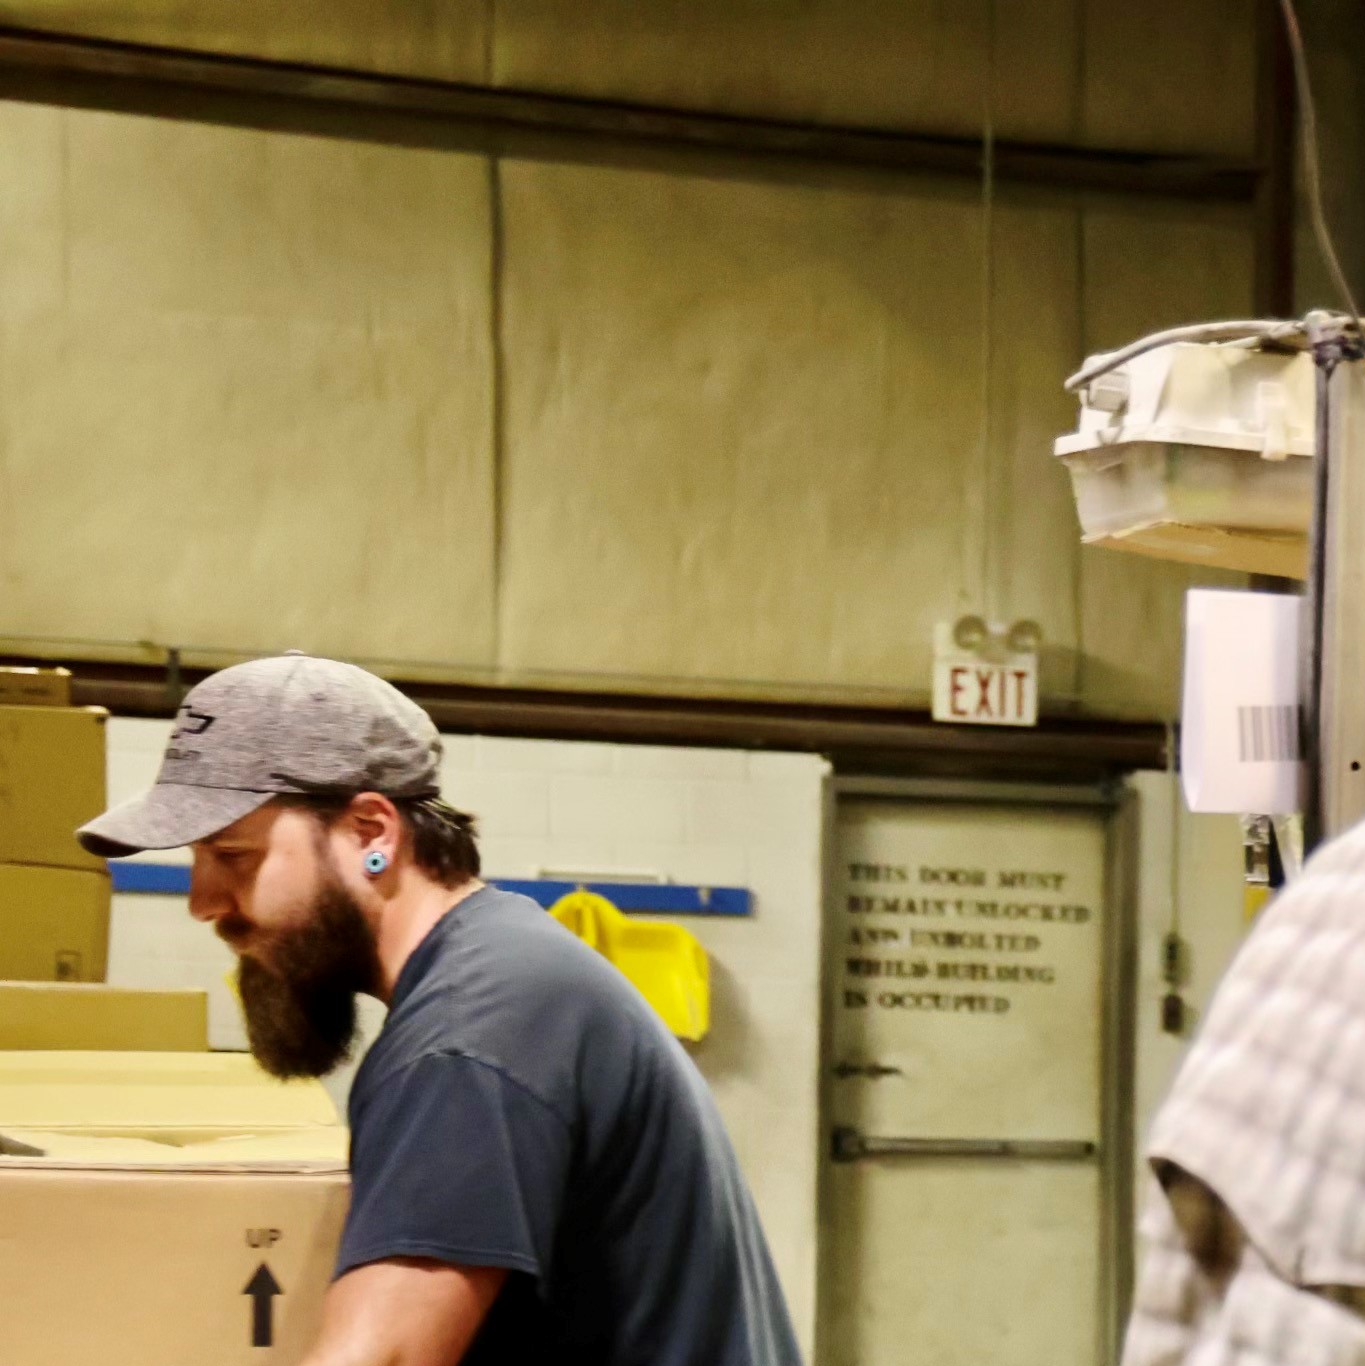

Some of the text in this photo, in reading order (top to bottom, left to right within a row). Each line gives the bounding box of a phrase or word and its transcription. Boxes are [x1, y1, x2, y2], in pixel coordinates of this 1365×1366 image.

[950, 666, 1029, 718] EXIT
[848, 863, 1066, 891] THIS DOOR MUST
[847, 895, 1091, 923] REMAIN UNLOCKED
[908, 929, 1041, 950] UNBOLTED
[935, 960, 1055, 984] BUILDING
[844, 989, 1011, 1015] IS OCCUPIED
[245, 1227, 282, 1249] UP
